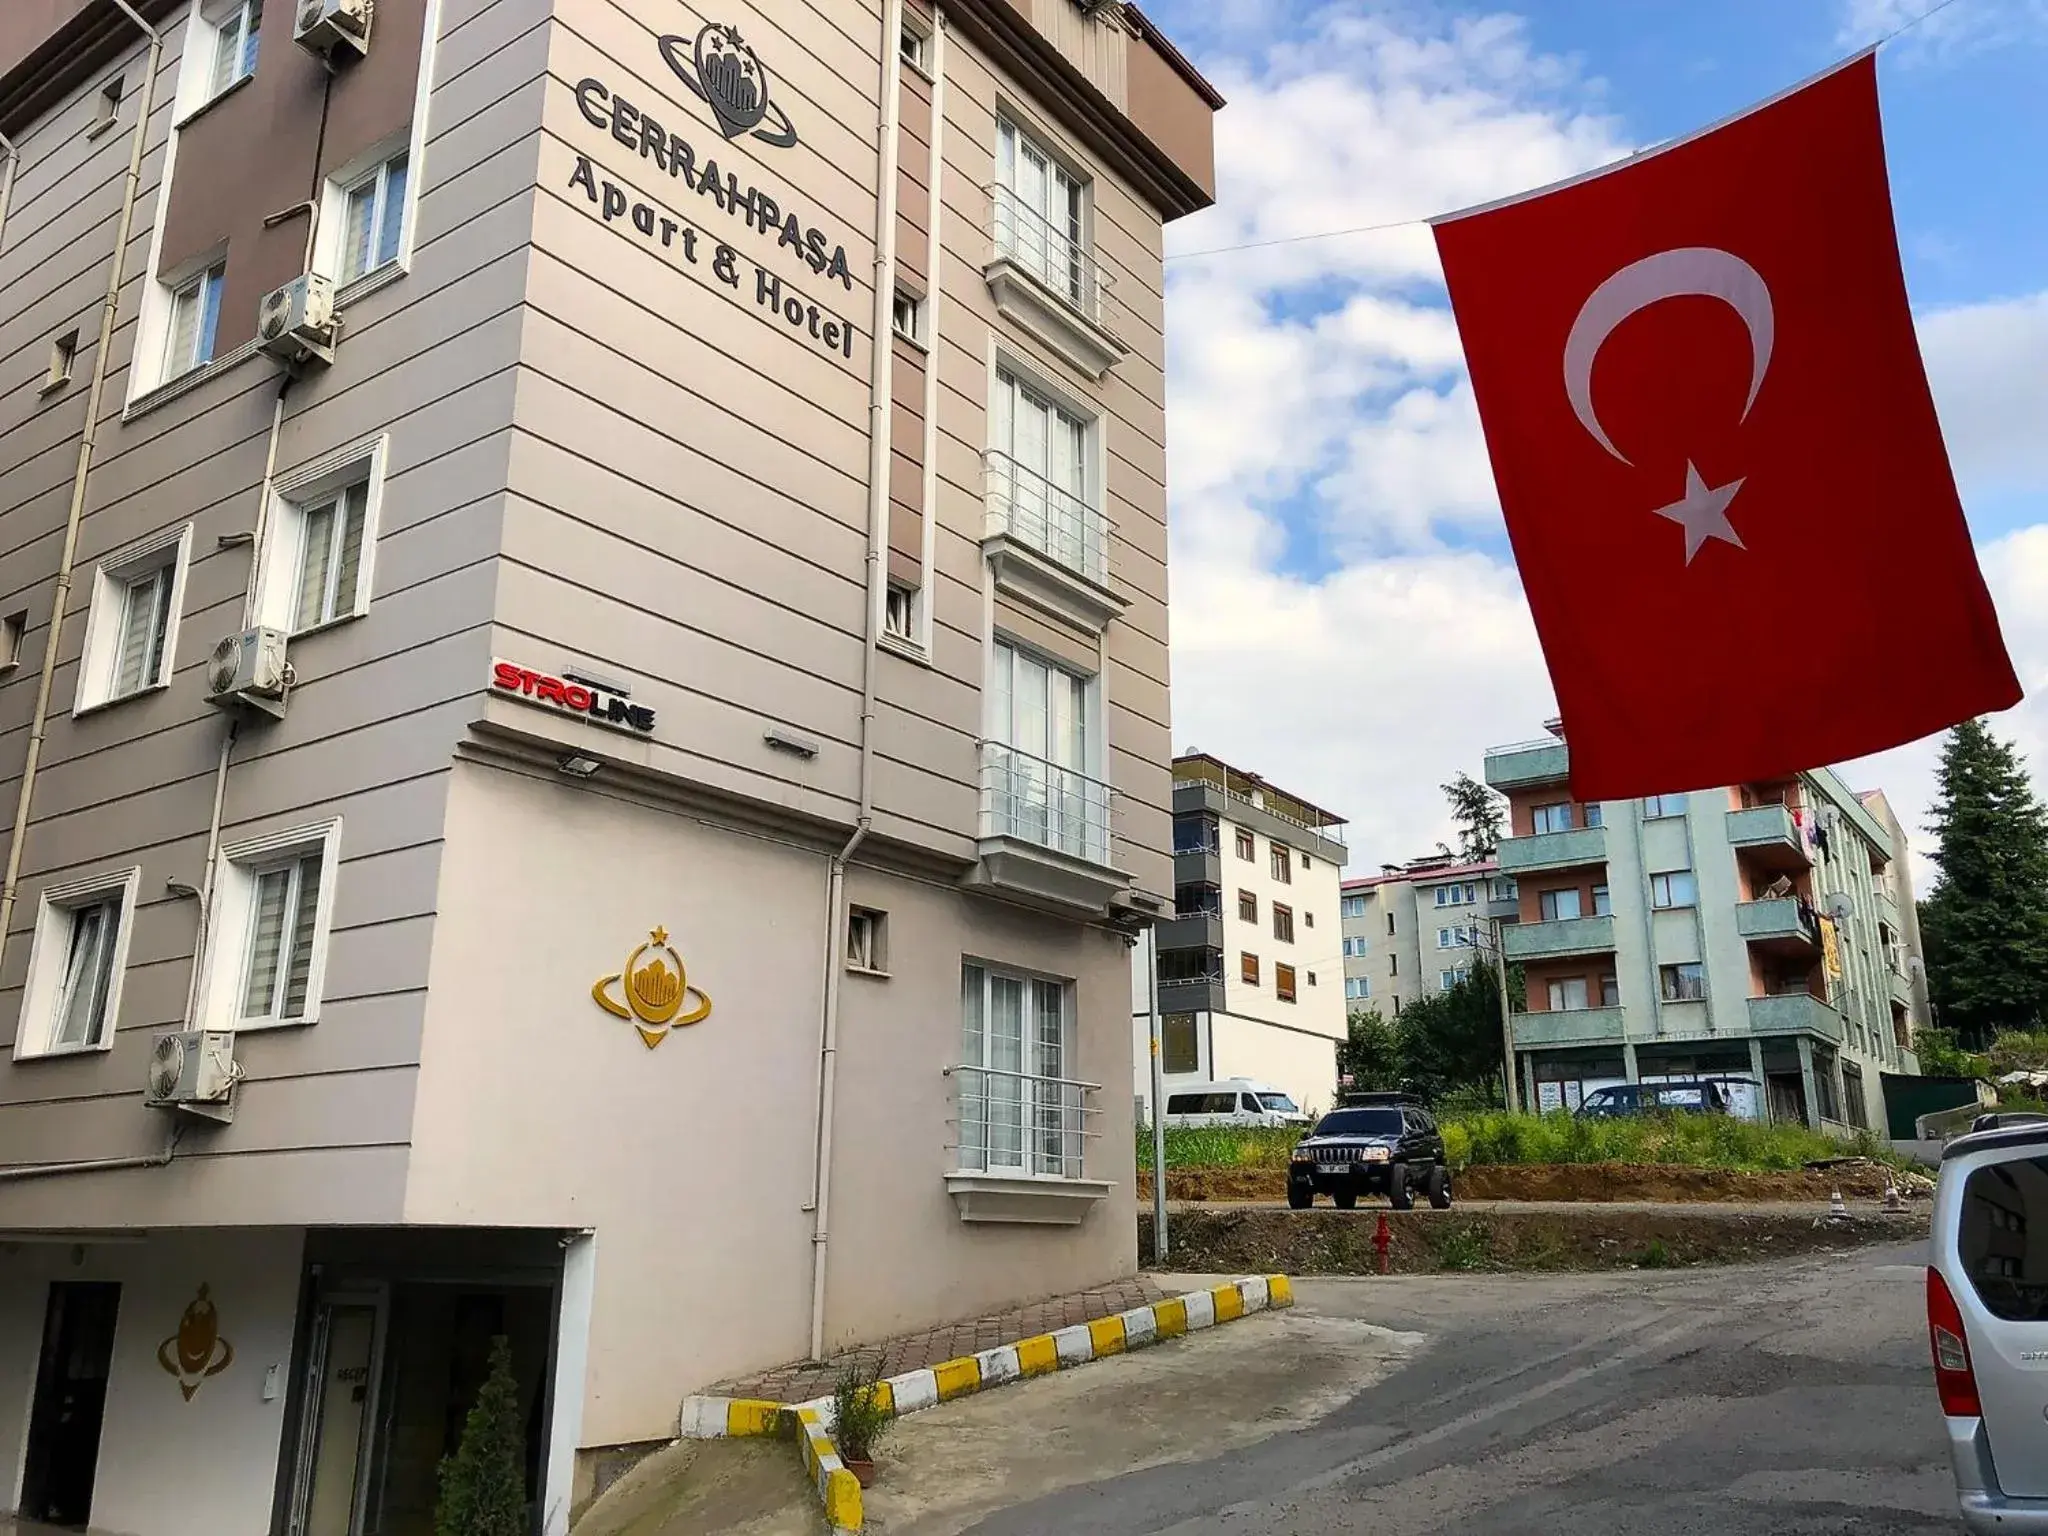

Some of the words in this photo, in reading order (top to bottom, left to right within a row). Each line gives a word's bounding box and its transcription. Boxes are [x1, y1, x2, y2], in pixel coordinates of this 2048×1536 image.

[568, 156, 697, 264] Apart
[713, 245, 738, 289] &
[755, 268, 853, 358] Hotel
[494, 663, 656, 732] STROLINE
